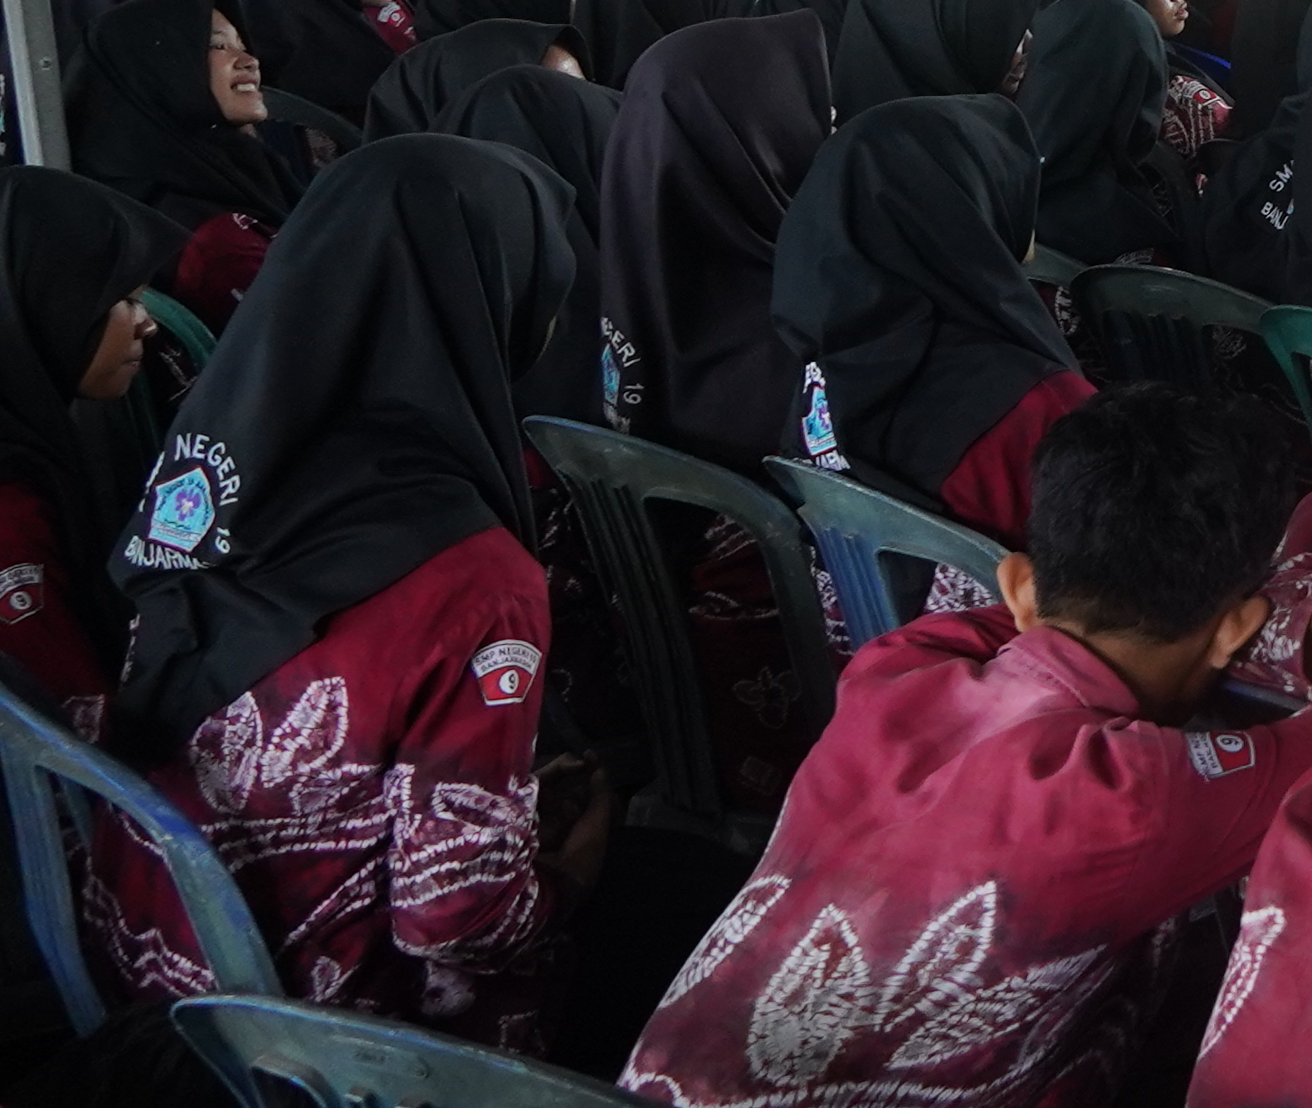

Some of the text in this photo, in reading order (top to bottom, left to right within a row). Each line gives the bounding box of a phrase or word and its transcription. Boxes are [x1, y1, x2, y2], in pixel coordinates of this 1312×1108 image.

[1268, 159, 1295, 192] SM
[624, 382, 645, 404] 19
[174, 432, 242, 507] NEGERI
[215, 526, 231, 554] 19
